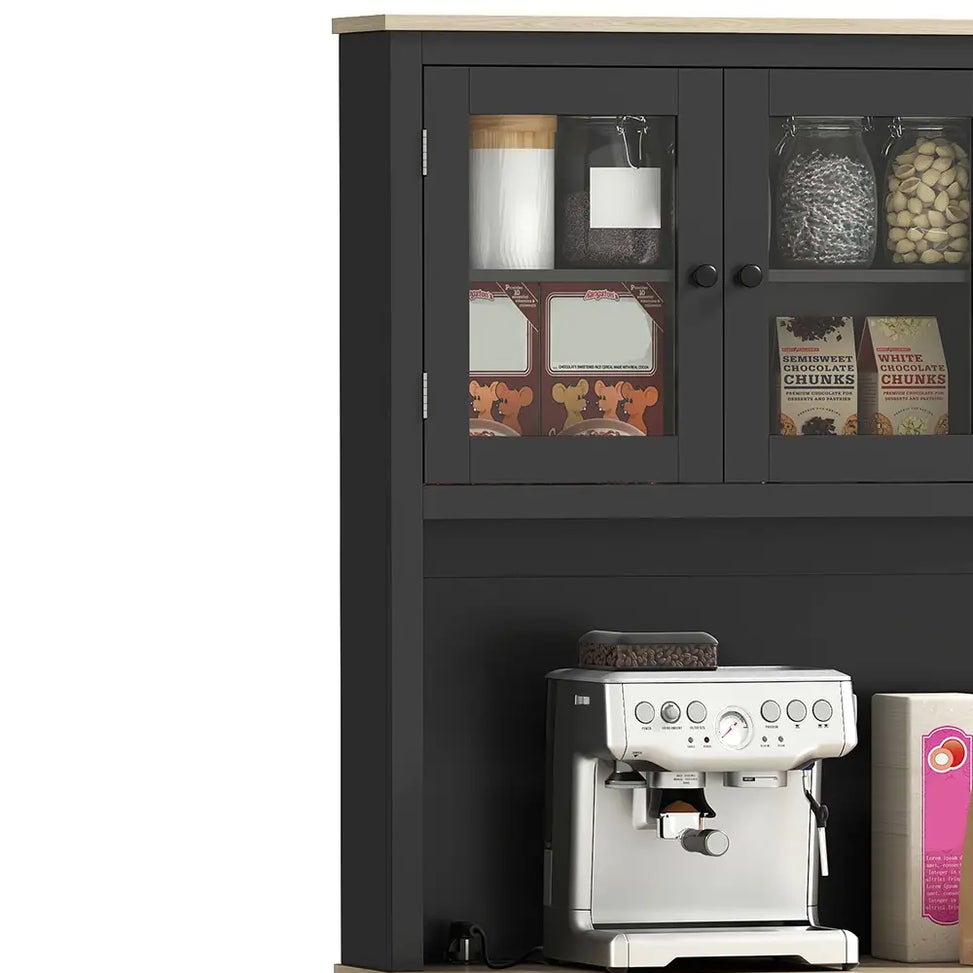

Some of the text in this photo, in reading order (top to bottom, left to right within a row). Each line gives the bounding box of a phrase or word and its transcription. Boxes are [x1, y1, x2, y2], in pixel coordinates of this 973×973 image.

[878, 354, 924, 362] WHITE
[784, 374, 855, 385] CHUNKS
[881, 374, 946, 385] CHUNKS
